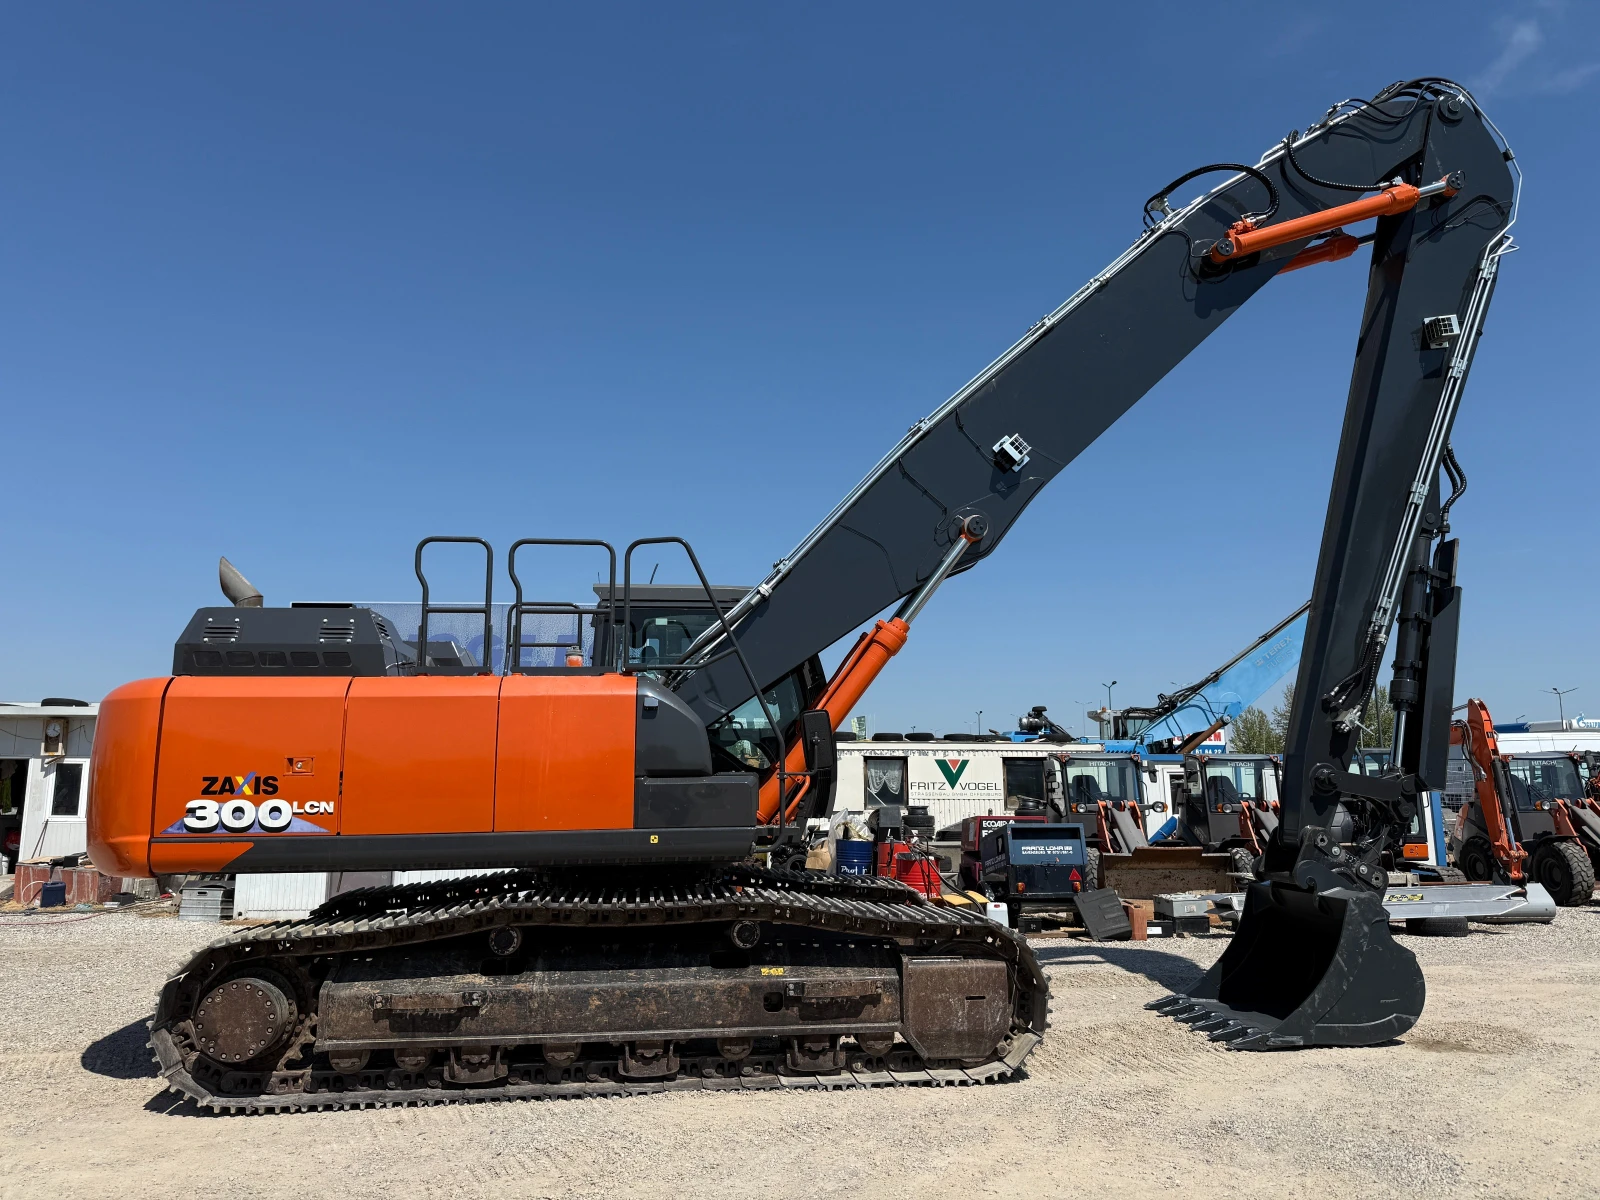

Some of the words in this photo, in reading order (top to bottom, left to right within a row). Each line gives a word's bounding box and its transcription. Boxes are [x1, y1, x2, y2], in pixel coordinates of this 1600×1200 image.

[1264, 636, 1293, 659] TEREX
[201, 772, 279, 796] ZAXIS
[910, 781, 947, 791] FRITZ
[959, 782, 1002, 791] VOGEL
[183, 799, 293, 833] 300
[292, 801, 334, 815] LCN
